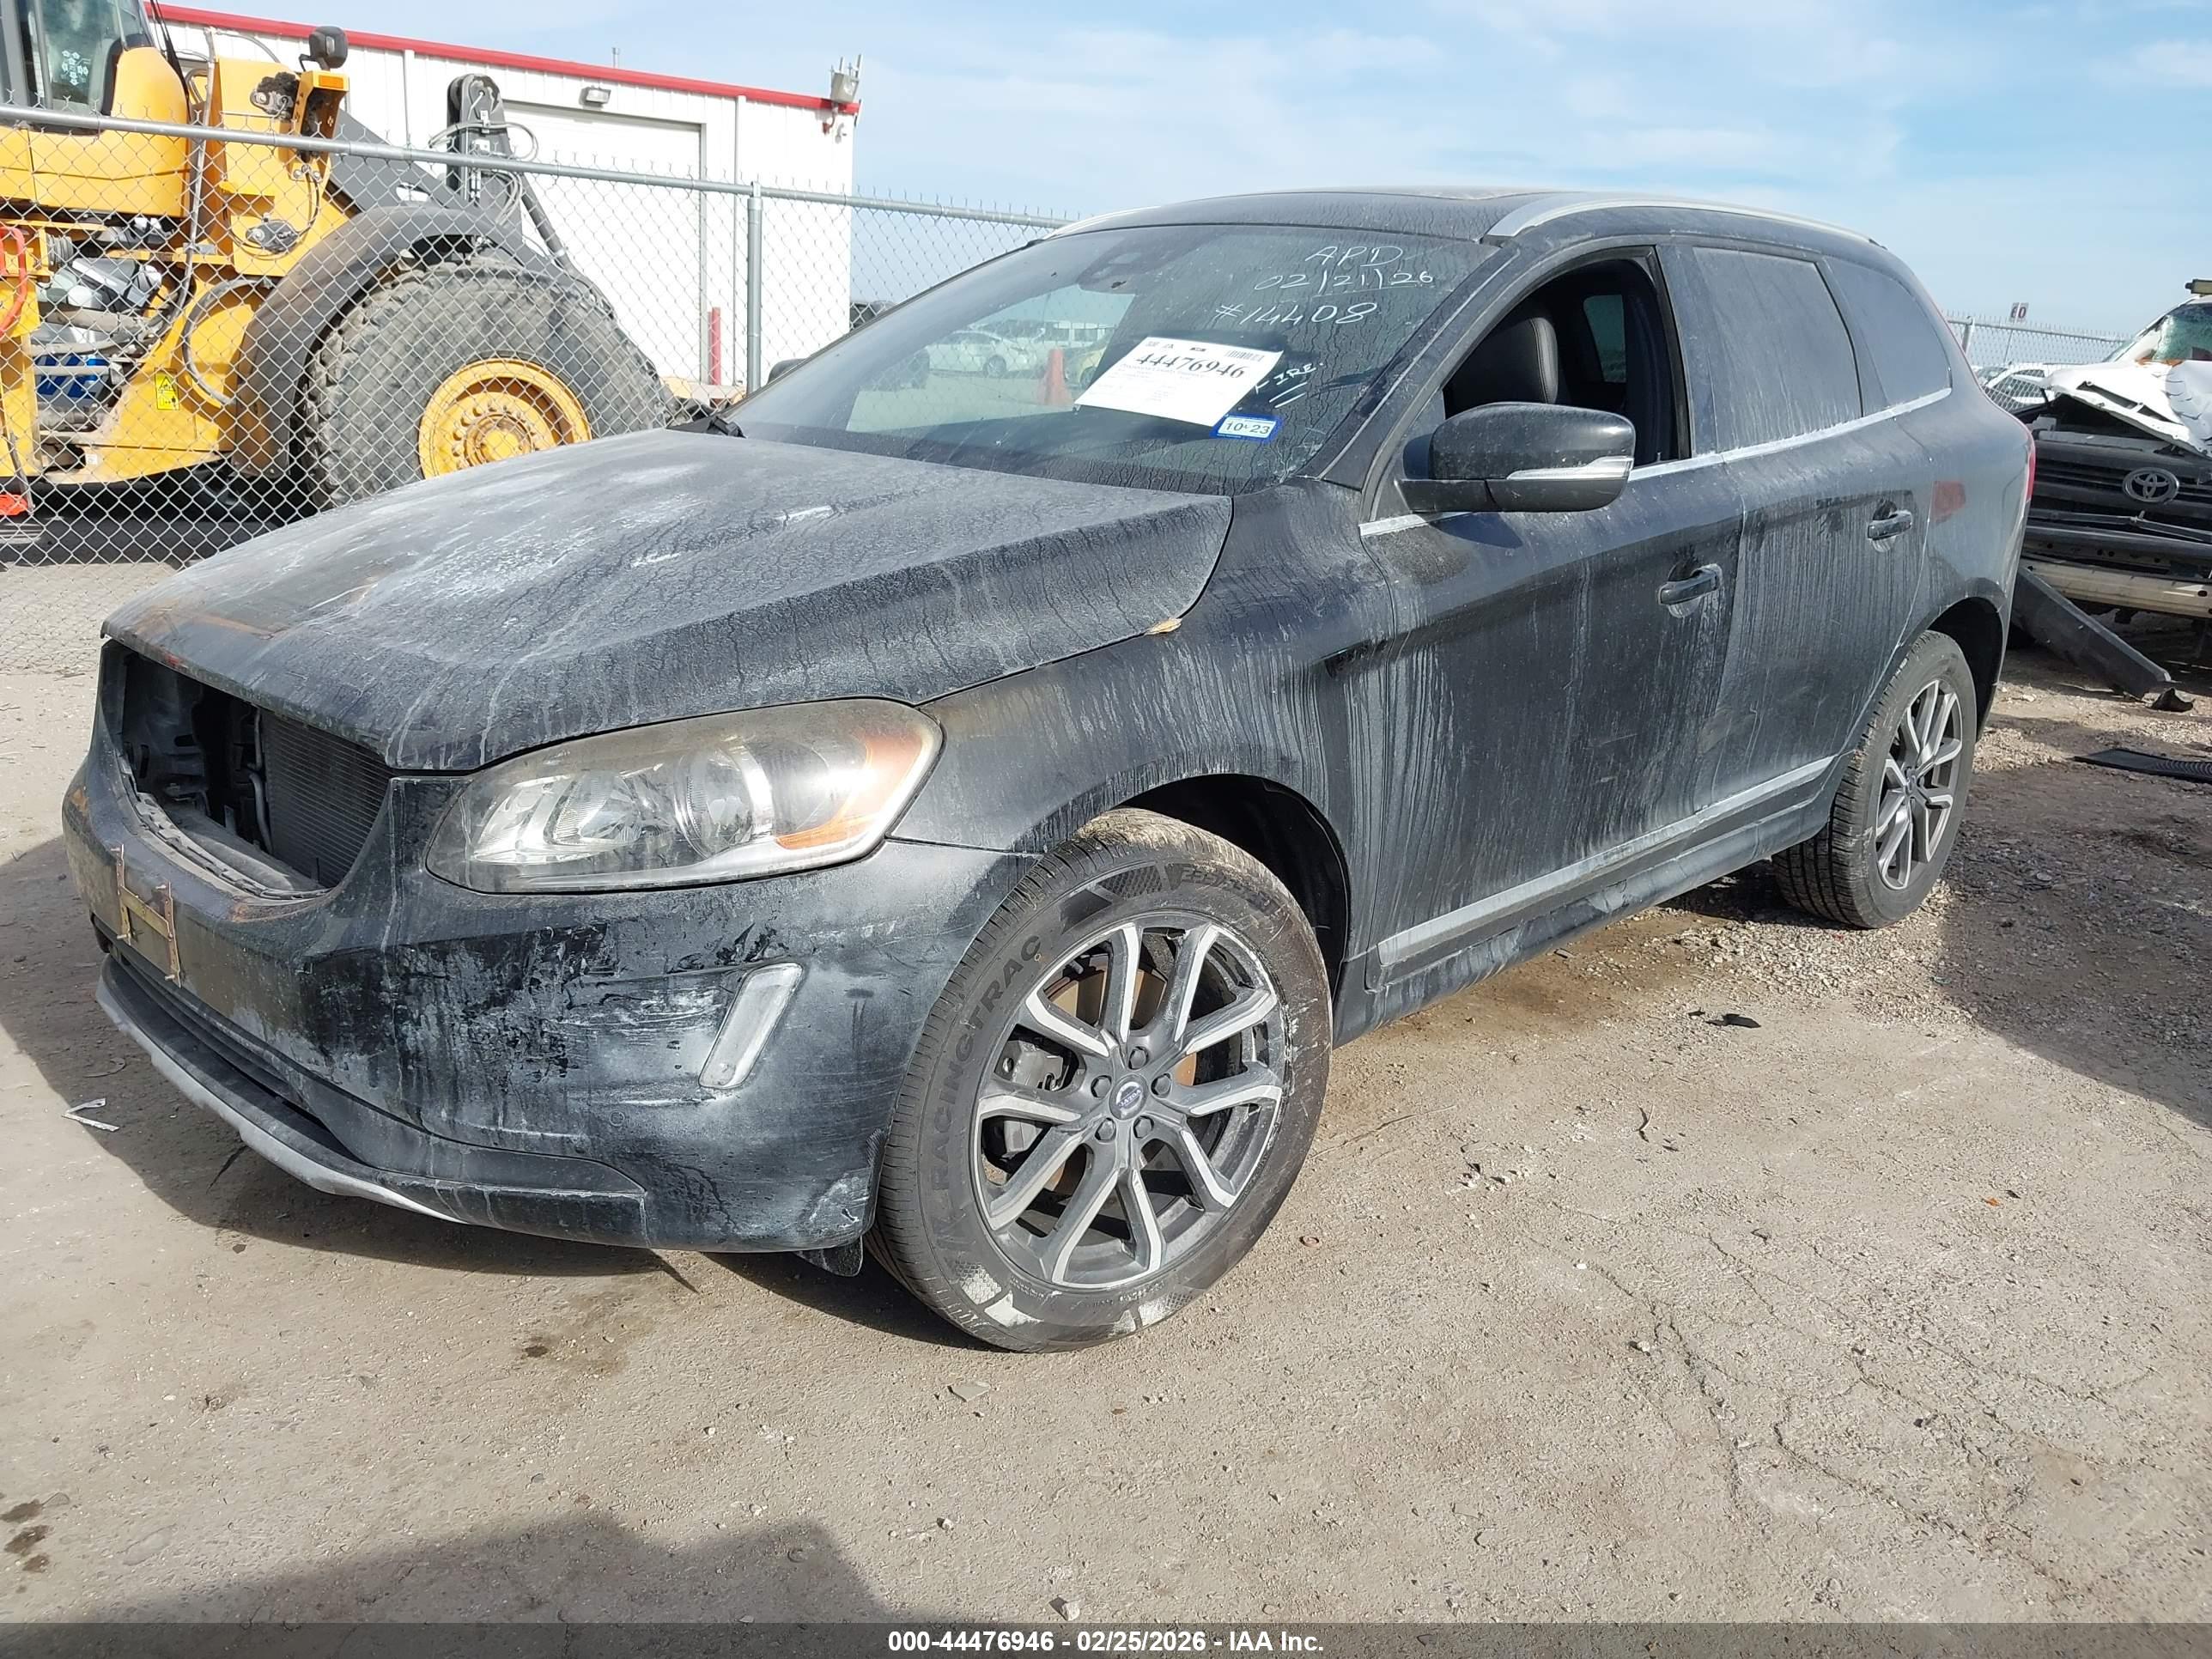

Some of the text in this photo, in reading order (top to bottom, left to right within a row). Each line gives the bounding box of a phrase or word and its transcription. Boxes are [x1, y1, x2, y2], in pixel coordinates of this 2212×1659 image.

[1304, 246, 1403, 267] APD
[1254, 268, 1434, 294] 02/21/26
[1213, 302, 1378, 326] #14408
[1136, 353, 1249, 379] 44476946
